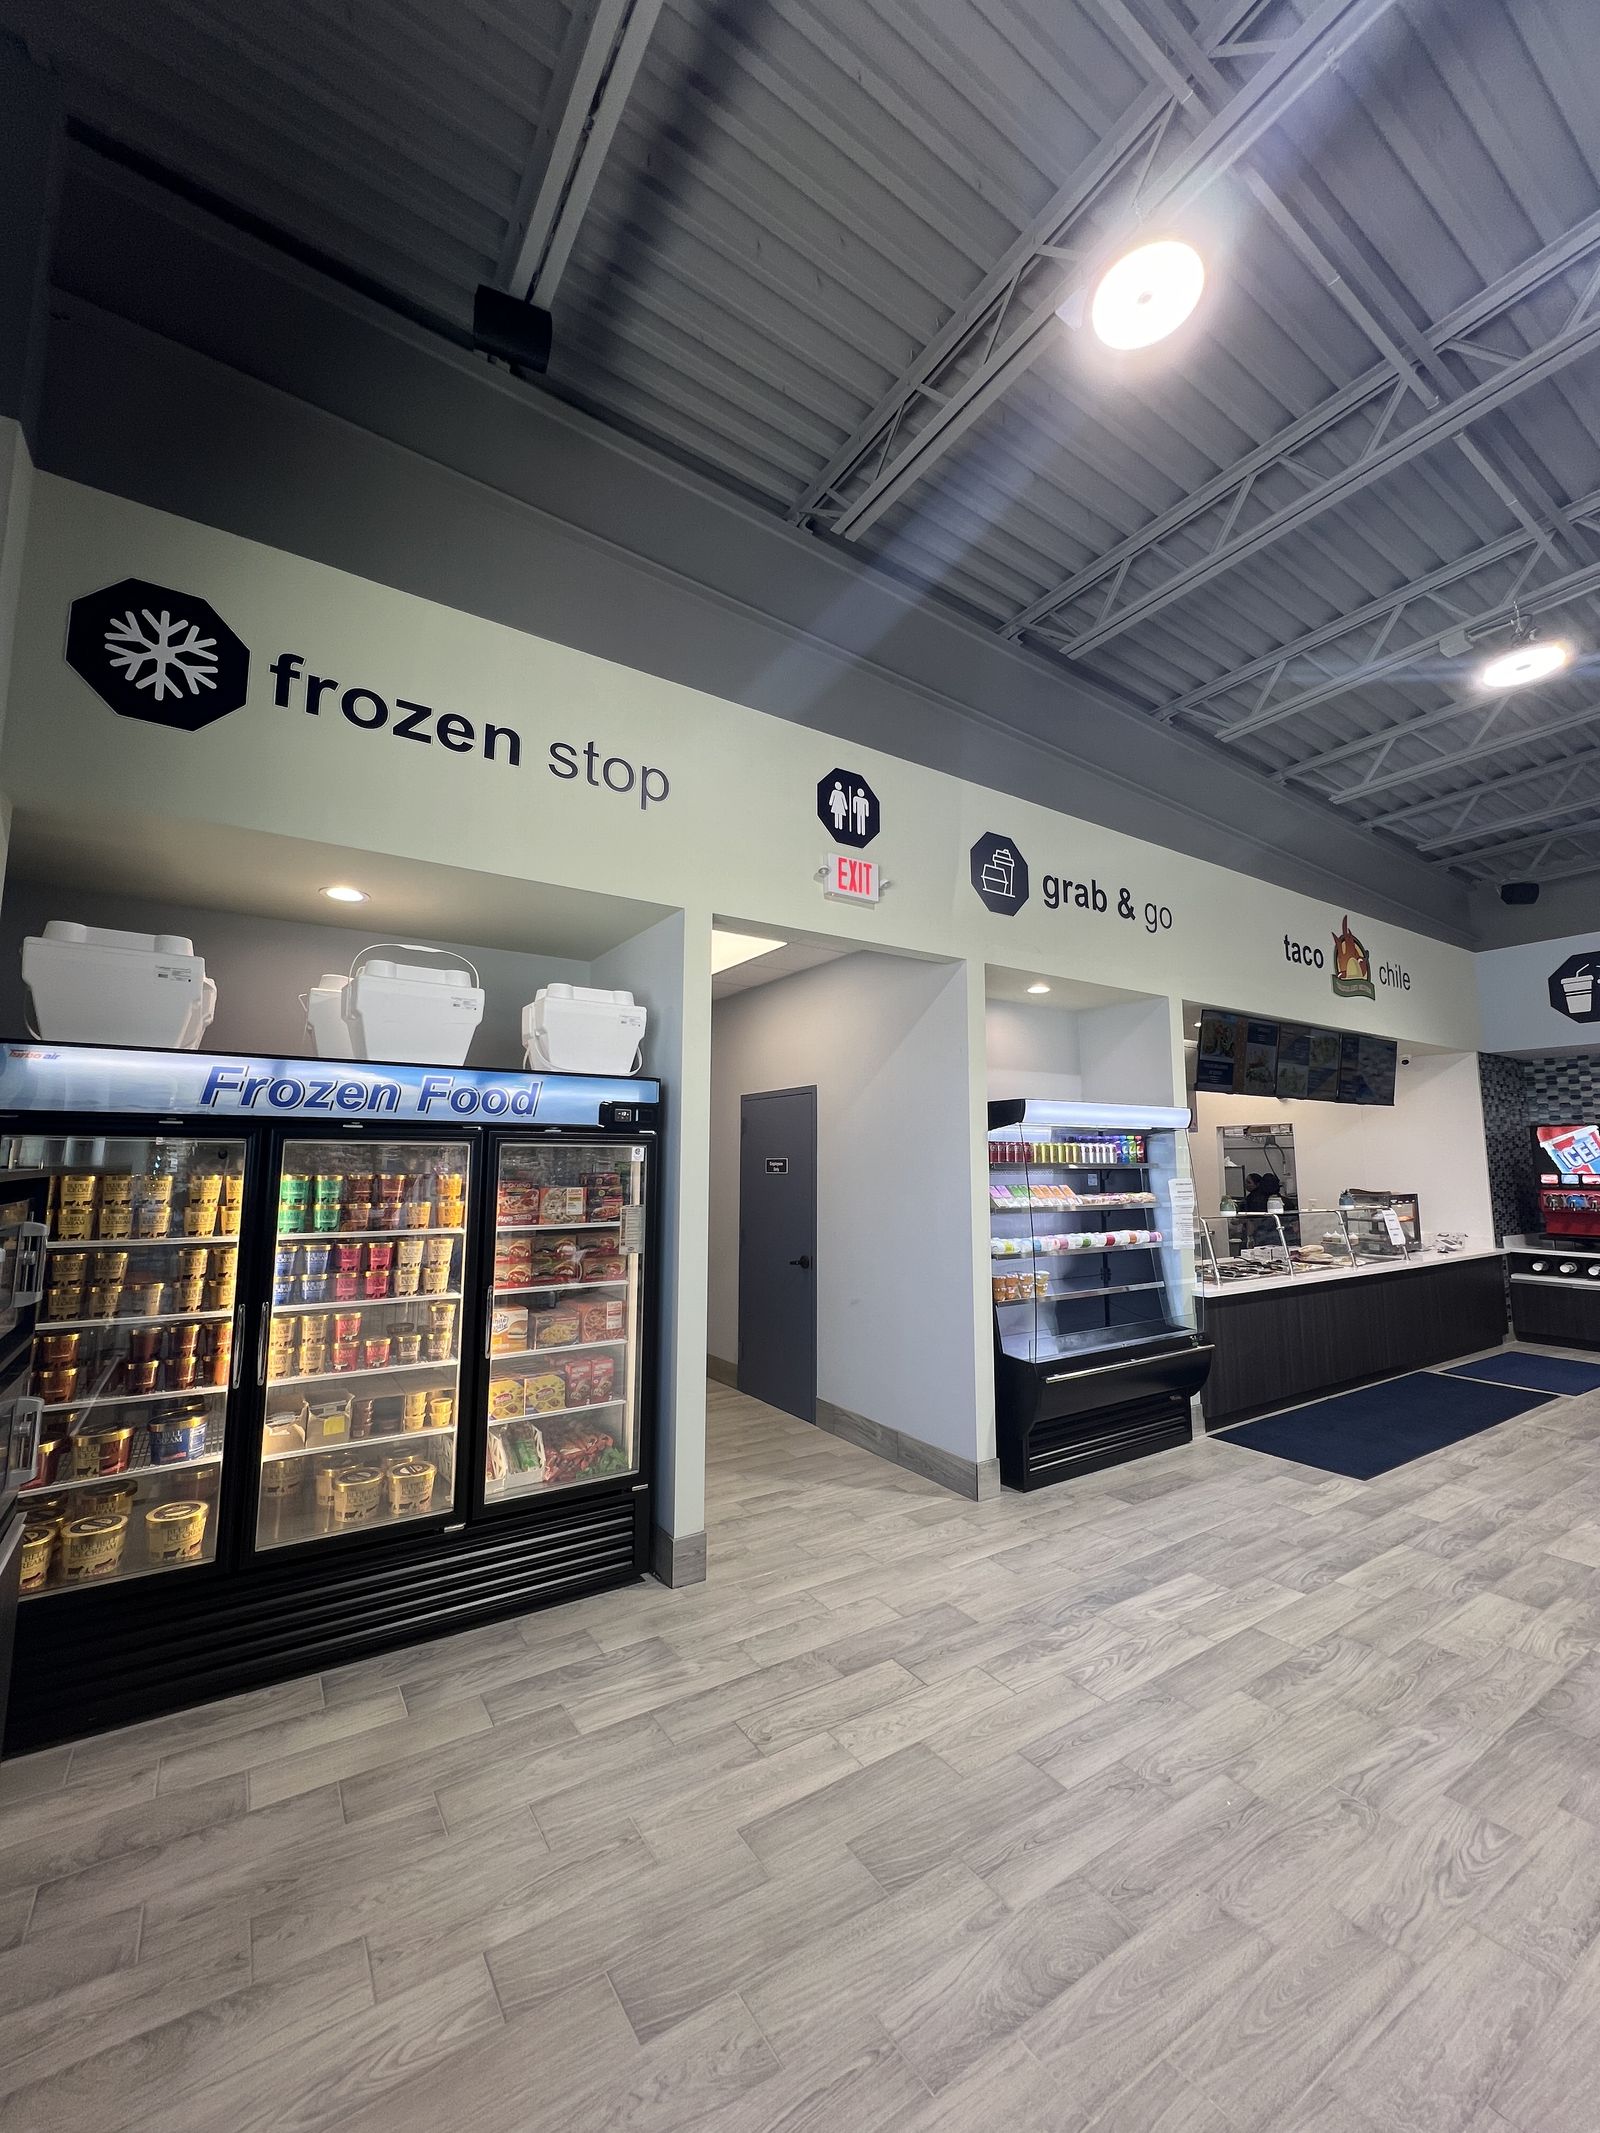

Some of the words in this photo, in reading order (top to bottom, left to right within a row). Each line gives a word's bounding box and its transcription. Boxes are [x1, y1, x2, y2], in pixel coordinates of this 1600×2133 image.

[269, 654, 521, 766] frozen
[548, 740, 671, 810] stop
[837, 857, 872, 896] EXIT
[1042, 875, 1107, 912] grab
[1118, 888, 1136, 920] &
[1145, 902, 1173, 933] go
[1284, 934, 1324, 968] taco
[1379, 962, 1411, 990] chile
[200, 1064, 401, 1114] Frozen
[417, 1075, 543, 1117] Food
[1557, 1140, 1600, 1169] ICEE
